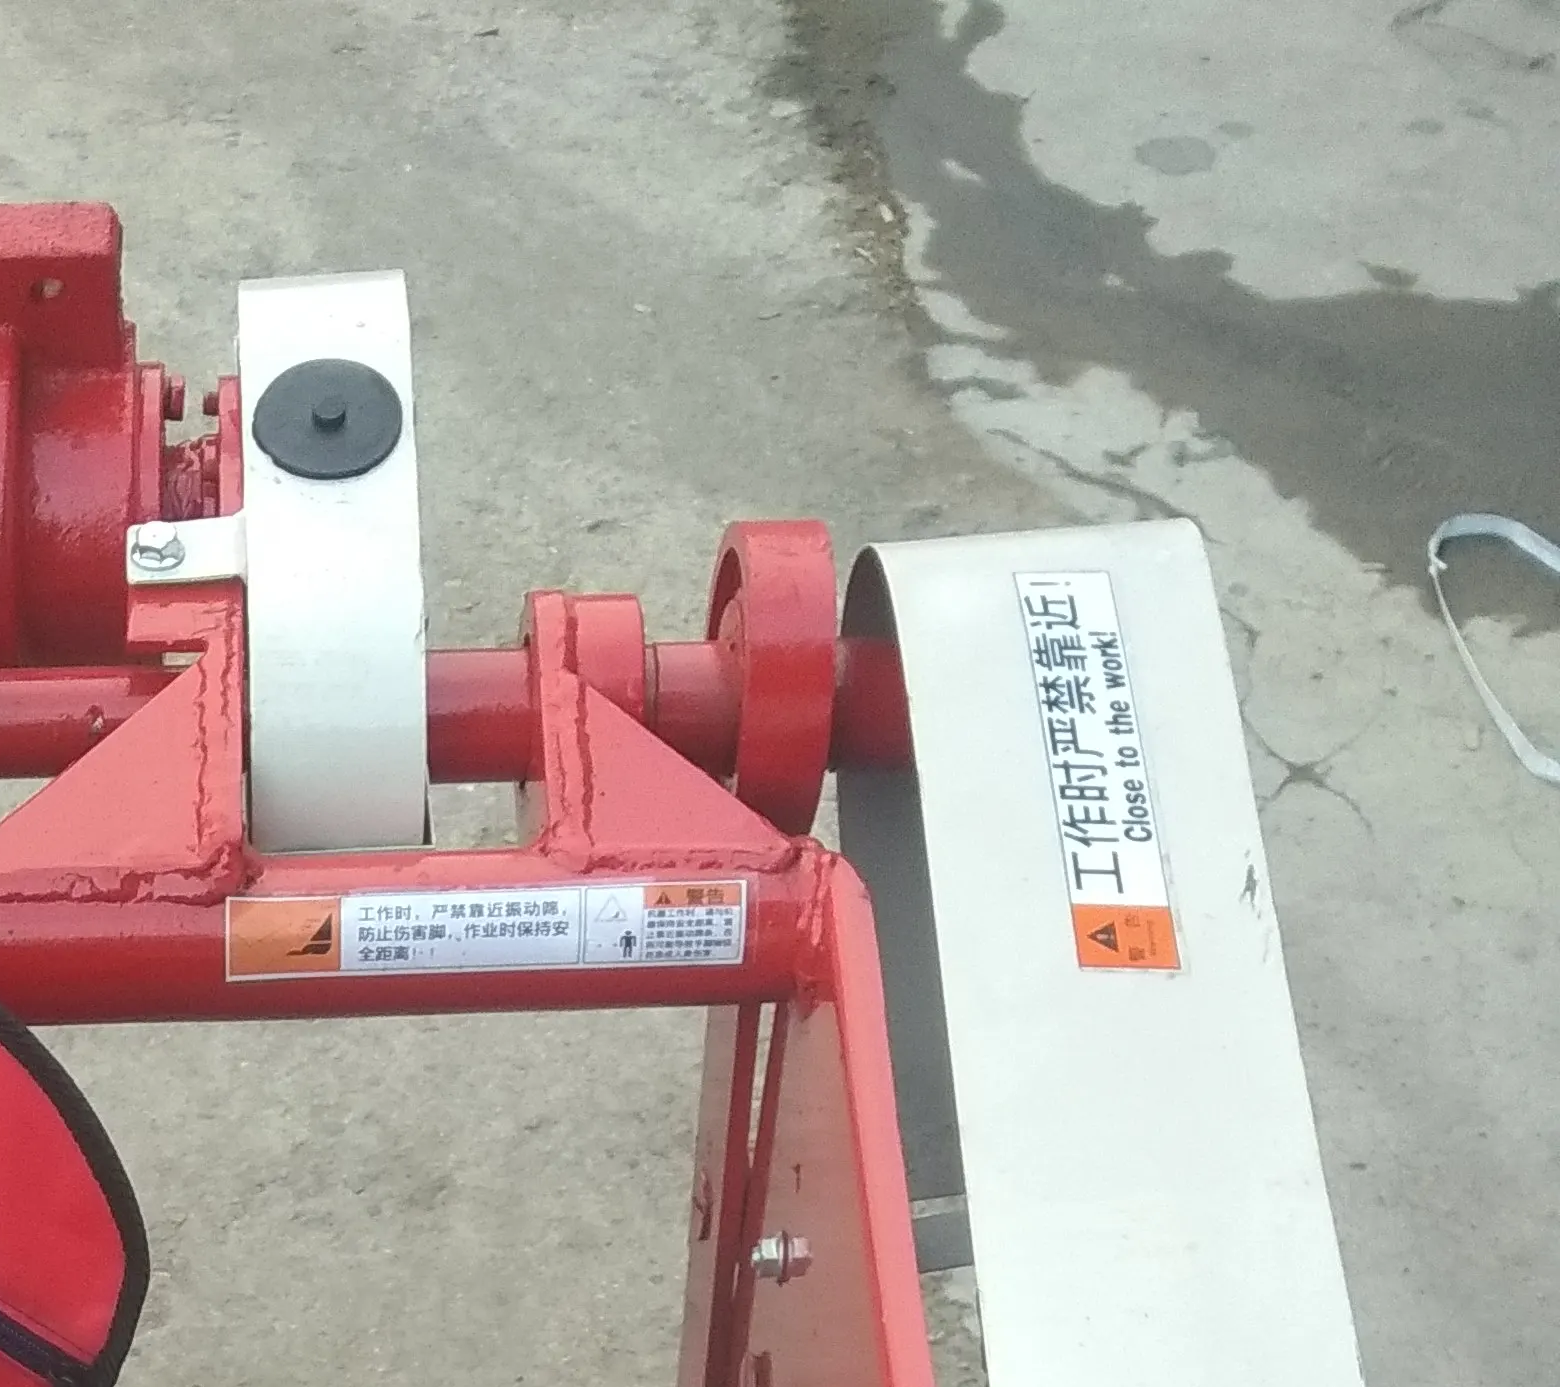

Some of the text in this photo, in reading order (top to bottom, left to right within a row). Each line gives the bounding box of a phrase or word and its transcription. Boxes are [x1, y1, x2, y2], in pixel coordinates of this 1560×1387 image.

[1088, 631, 1152, 842] Close to the work!
